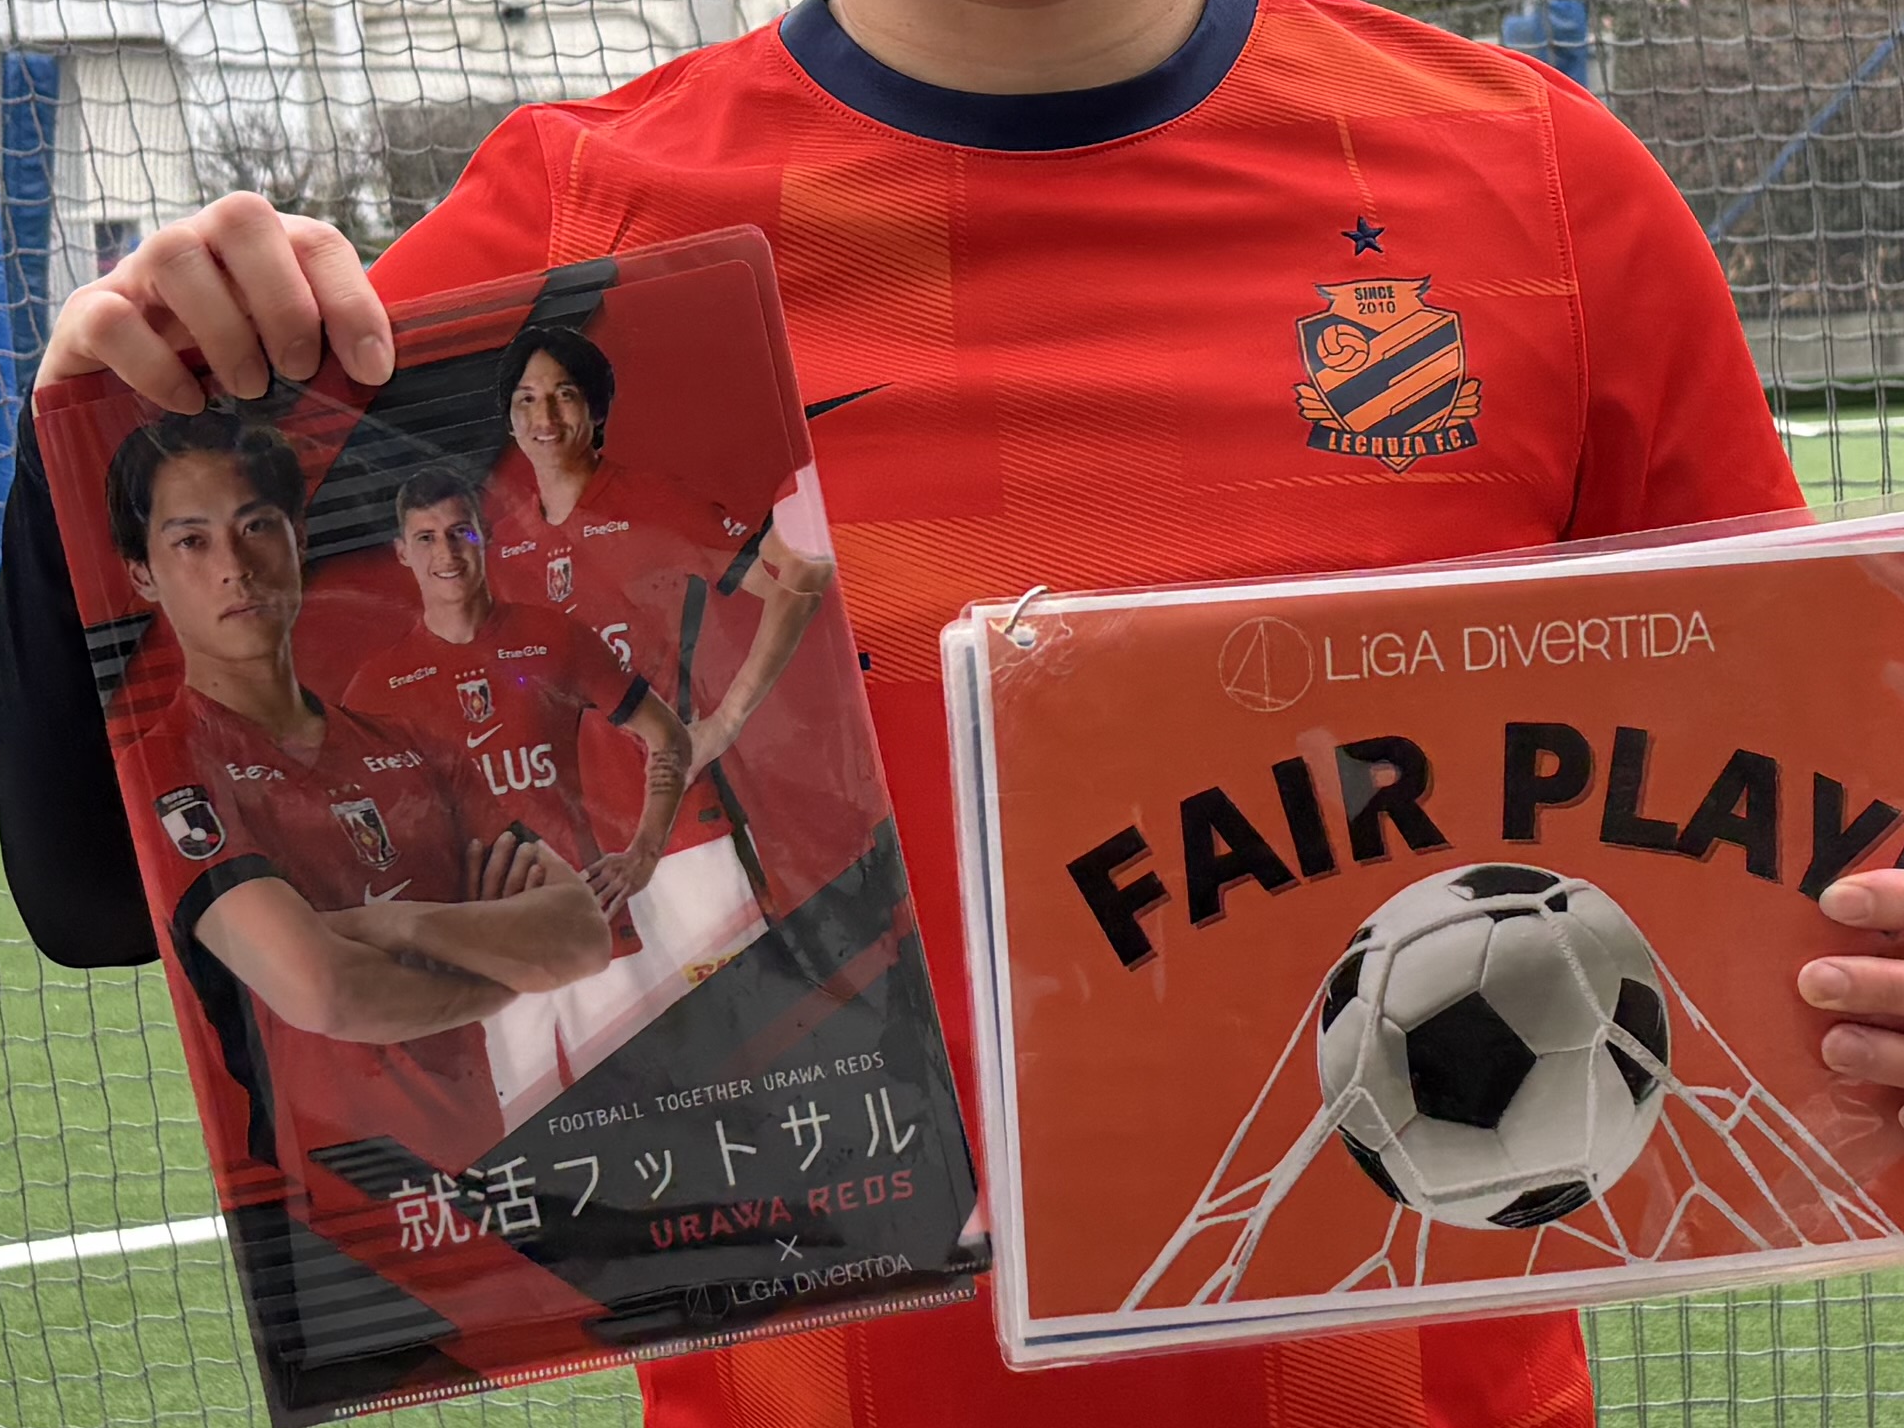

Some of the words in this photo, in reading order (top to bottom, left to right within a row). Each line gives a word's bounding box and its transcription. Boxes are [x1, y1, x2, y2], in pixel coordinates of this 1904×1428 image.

[1354, 285, 1396, 301] SINCE
[1357, 301, 1396, 315] 2010
[1328, 430, 1427, 456] LECHUZA
[1064, 733, 1454, 970] FAIR
[548, 1103, 645, 1136] FOOTBALL
[654, 1079, 753, 1113] TOGETHER
[762, 1069, 826, 1092] URAWA
[835, 1051, 885, 1073] REDS
[389, 1087, 916, 1252] 就活フットサル
[649, 1195, 793, 1250] URAWA
[807, 1169, 915, 1217] REDS
